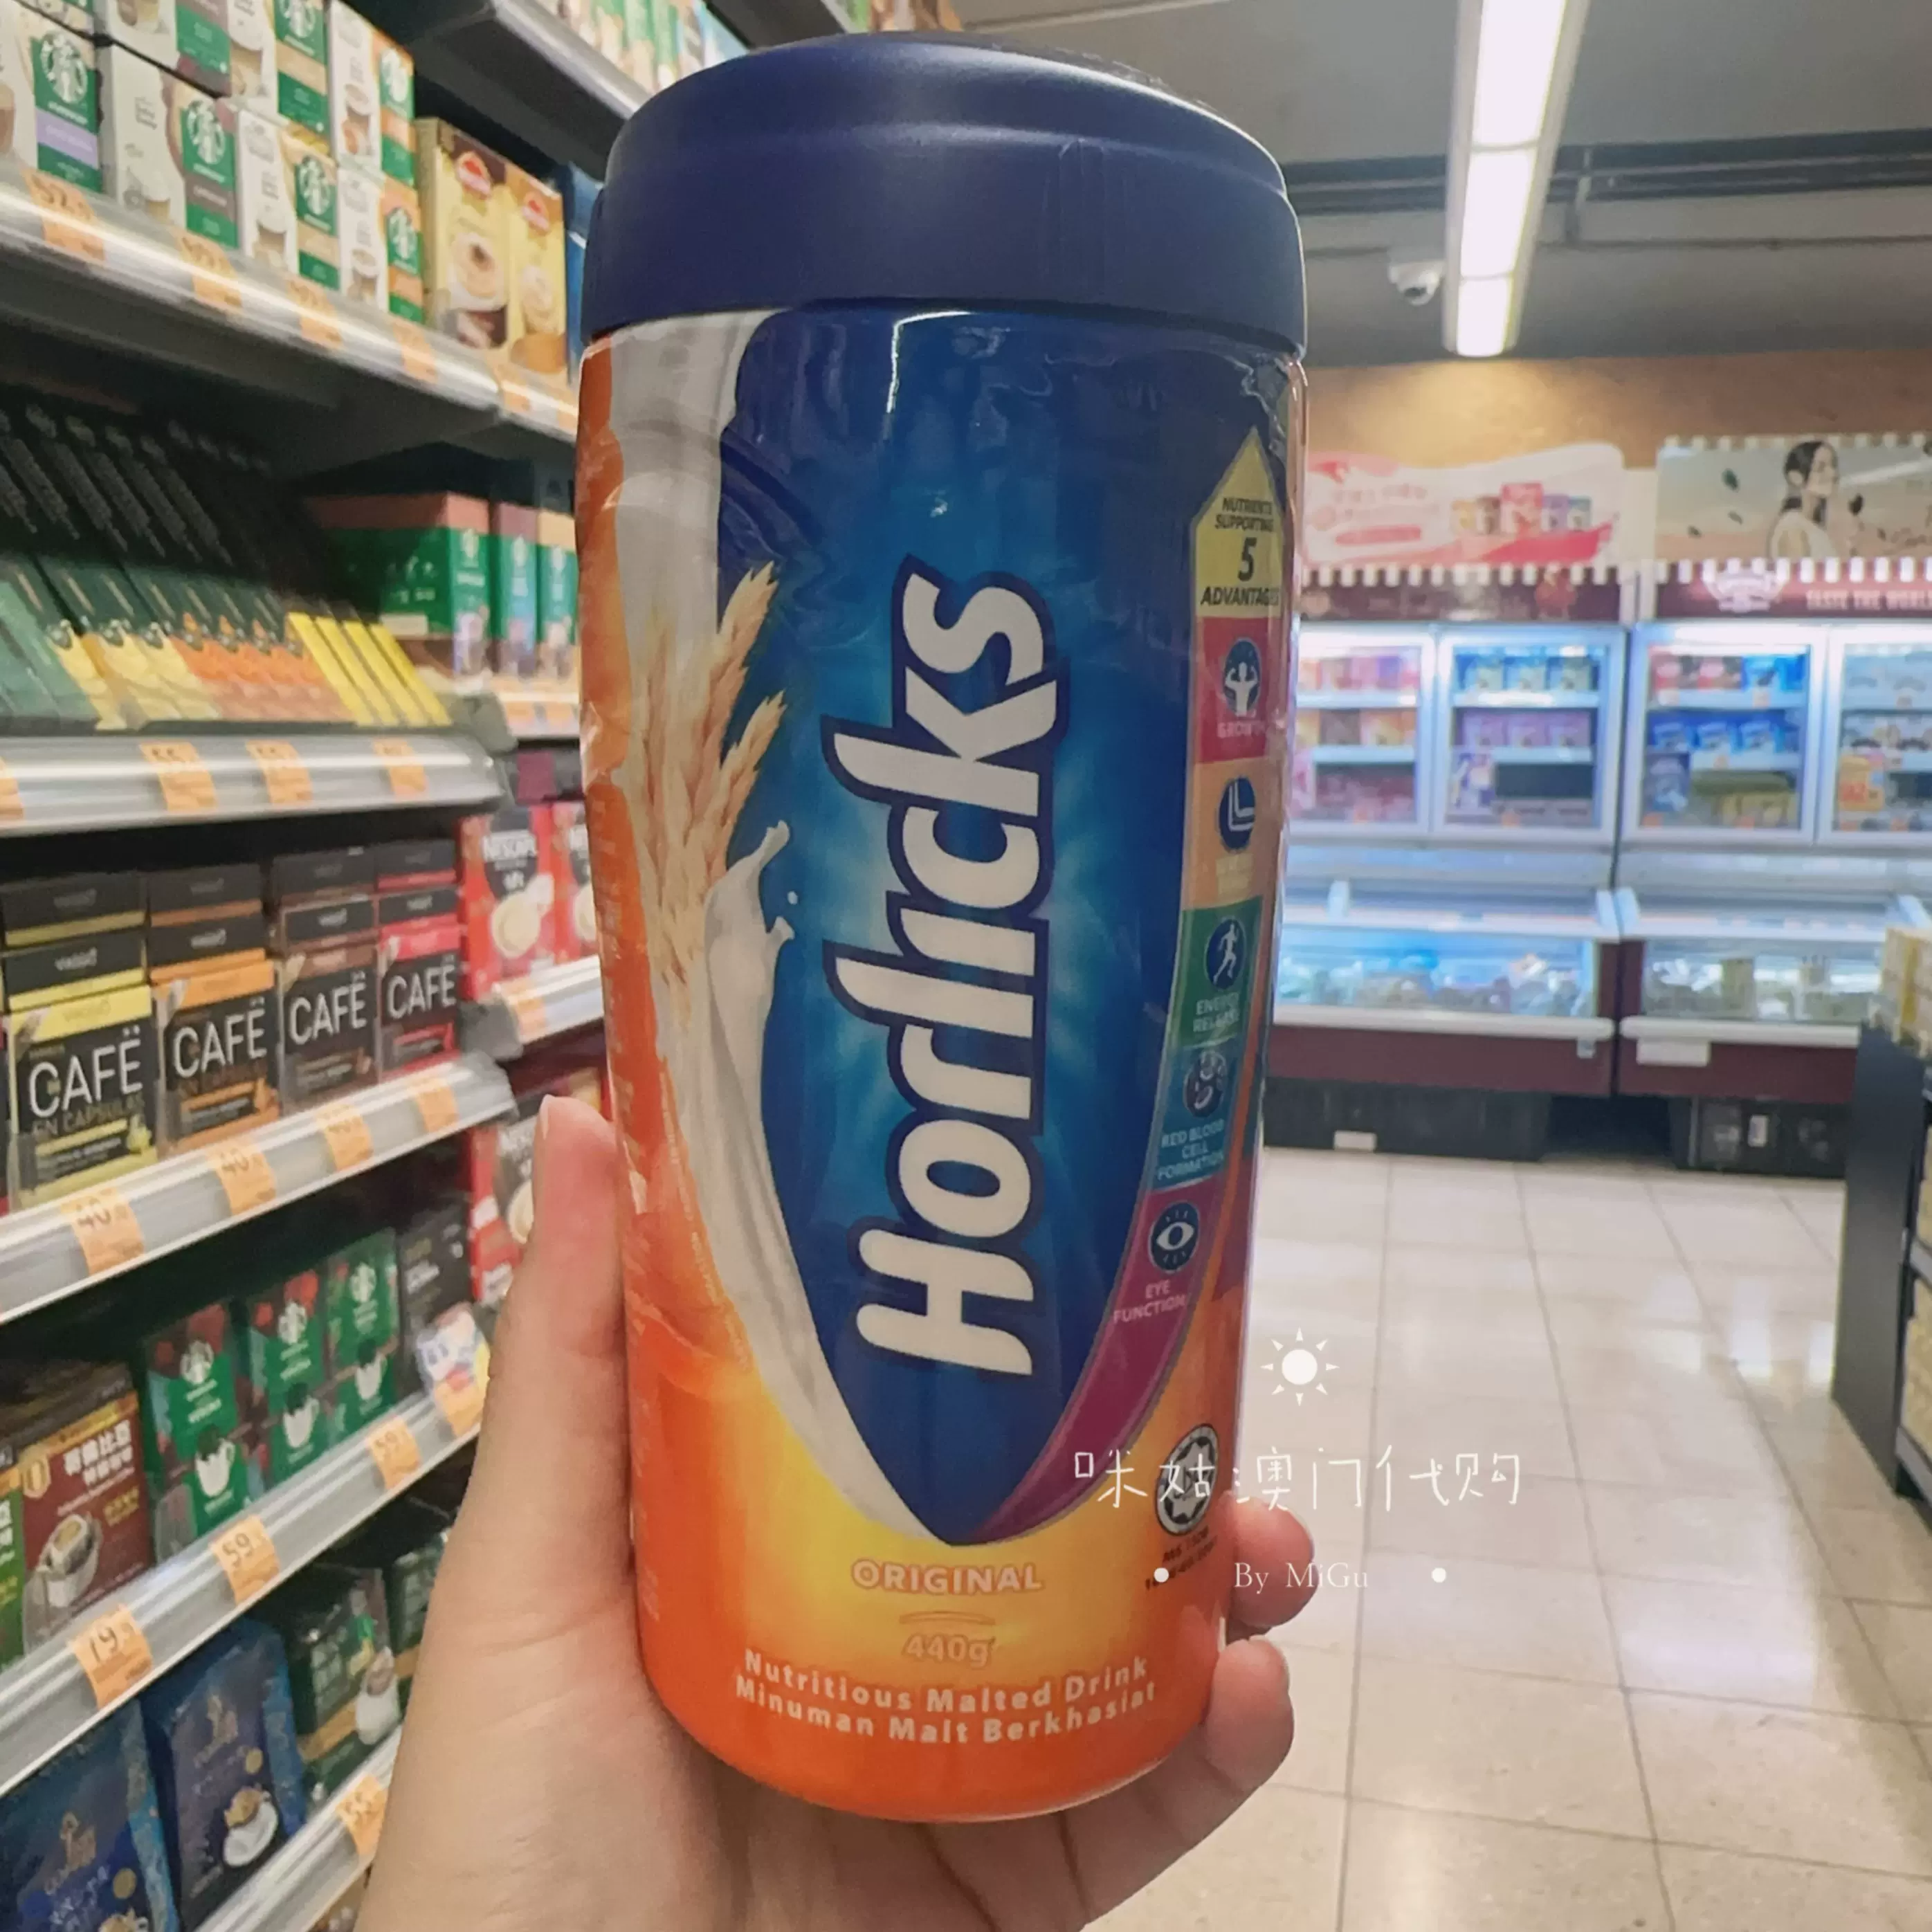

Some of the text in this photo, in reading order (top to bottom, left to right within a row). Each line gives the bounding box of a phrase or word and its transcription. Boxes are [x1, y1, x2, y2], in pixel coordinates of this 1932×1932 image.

[1237, 536, 1257, 582] 5
[830, 572, 1059, 1376] Horlicks
[1161, 1129, 1187, 1148] RED
[1181, 1142, 1209, 1160] CELL
[1145, 1279, 1170, 1299] EYE
[1113, 1294, 1187, 1324] FUNCTION
[851, 1559, 1043, 1592] ORIGINAL
[906, 1634, 990, 1668] 440g
[744, 1648, 1149, 1713] Nutritious Malted Drink
[735, 1674, 1156, 1743] Minuman Malt Berkhasiat
